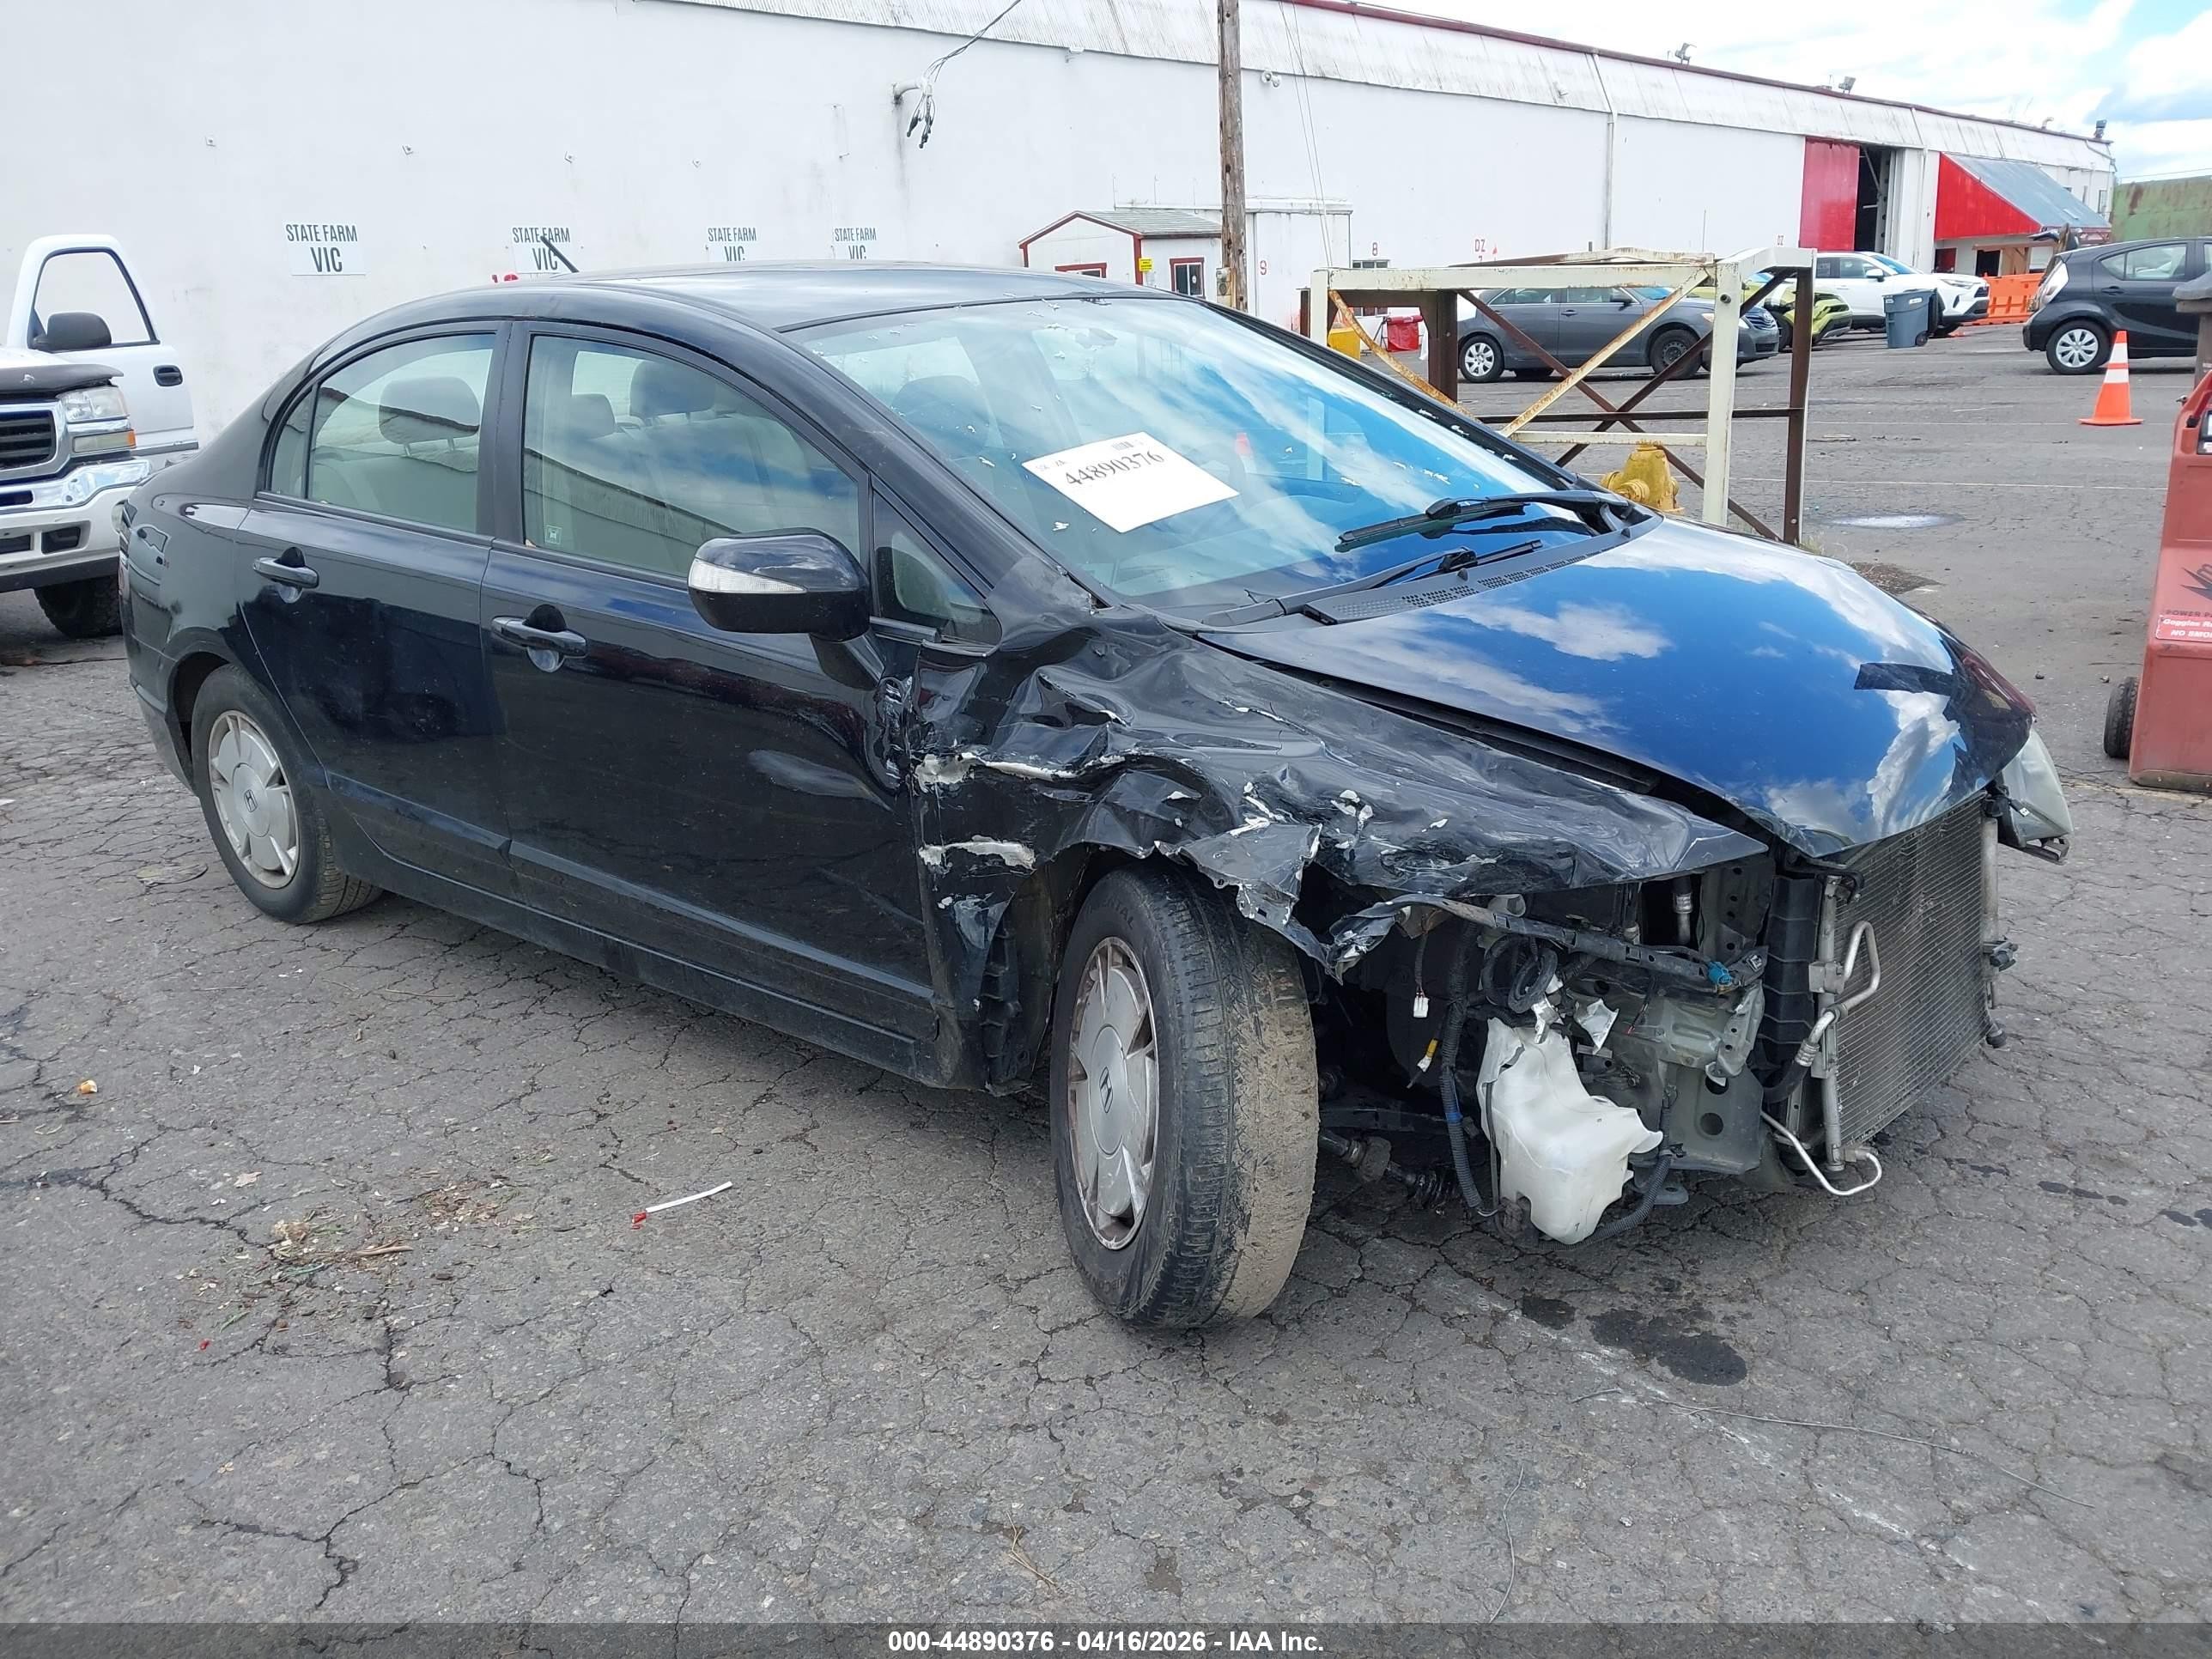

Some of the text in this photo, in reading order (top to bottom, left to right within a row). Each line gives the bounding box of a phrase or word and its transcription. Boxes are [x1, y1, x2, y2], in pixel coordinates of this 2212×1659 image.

[285, 224, 358, 242] STATE FARM
[512, 227, 570, 243] STATE FARM
[708, 227, 757, 242] STATE FARM
[835, 228, 877, 242] STATE FARM
[1371, 241, 1378, 257] 8
[310, 246, 343, 272] VIC
[532, 247, 558, 270] VIC
[1259, 260, 1267, 275] 9
[1065, 450, 1165, 486] 44890376
